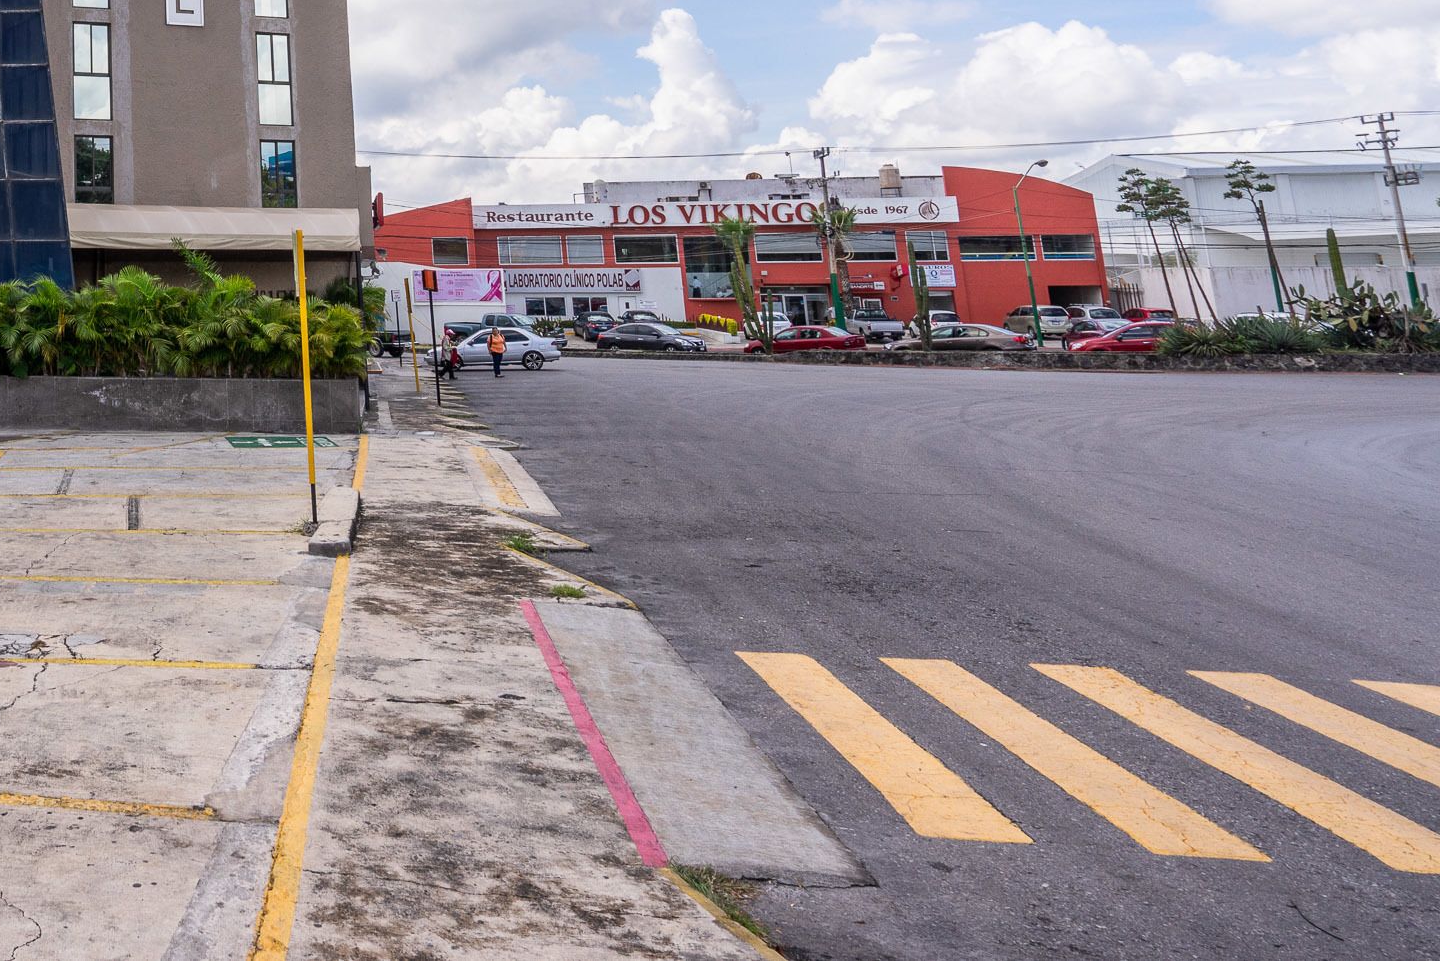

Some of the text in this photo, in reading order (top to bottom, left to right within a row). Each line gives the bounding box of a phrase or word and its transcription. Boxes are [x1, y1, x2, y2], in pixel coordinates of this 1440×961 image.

[486, 211, 594, 223] Restaurante
[609, 204, 667, 226] LOS
[885, 205, 909, 214] 1967
[508, 269, 624, 288] LABORATORIO CLÍNICO POLAB
